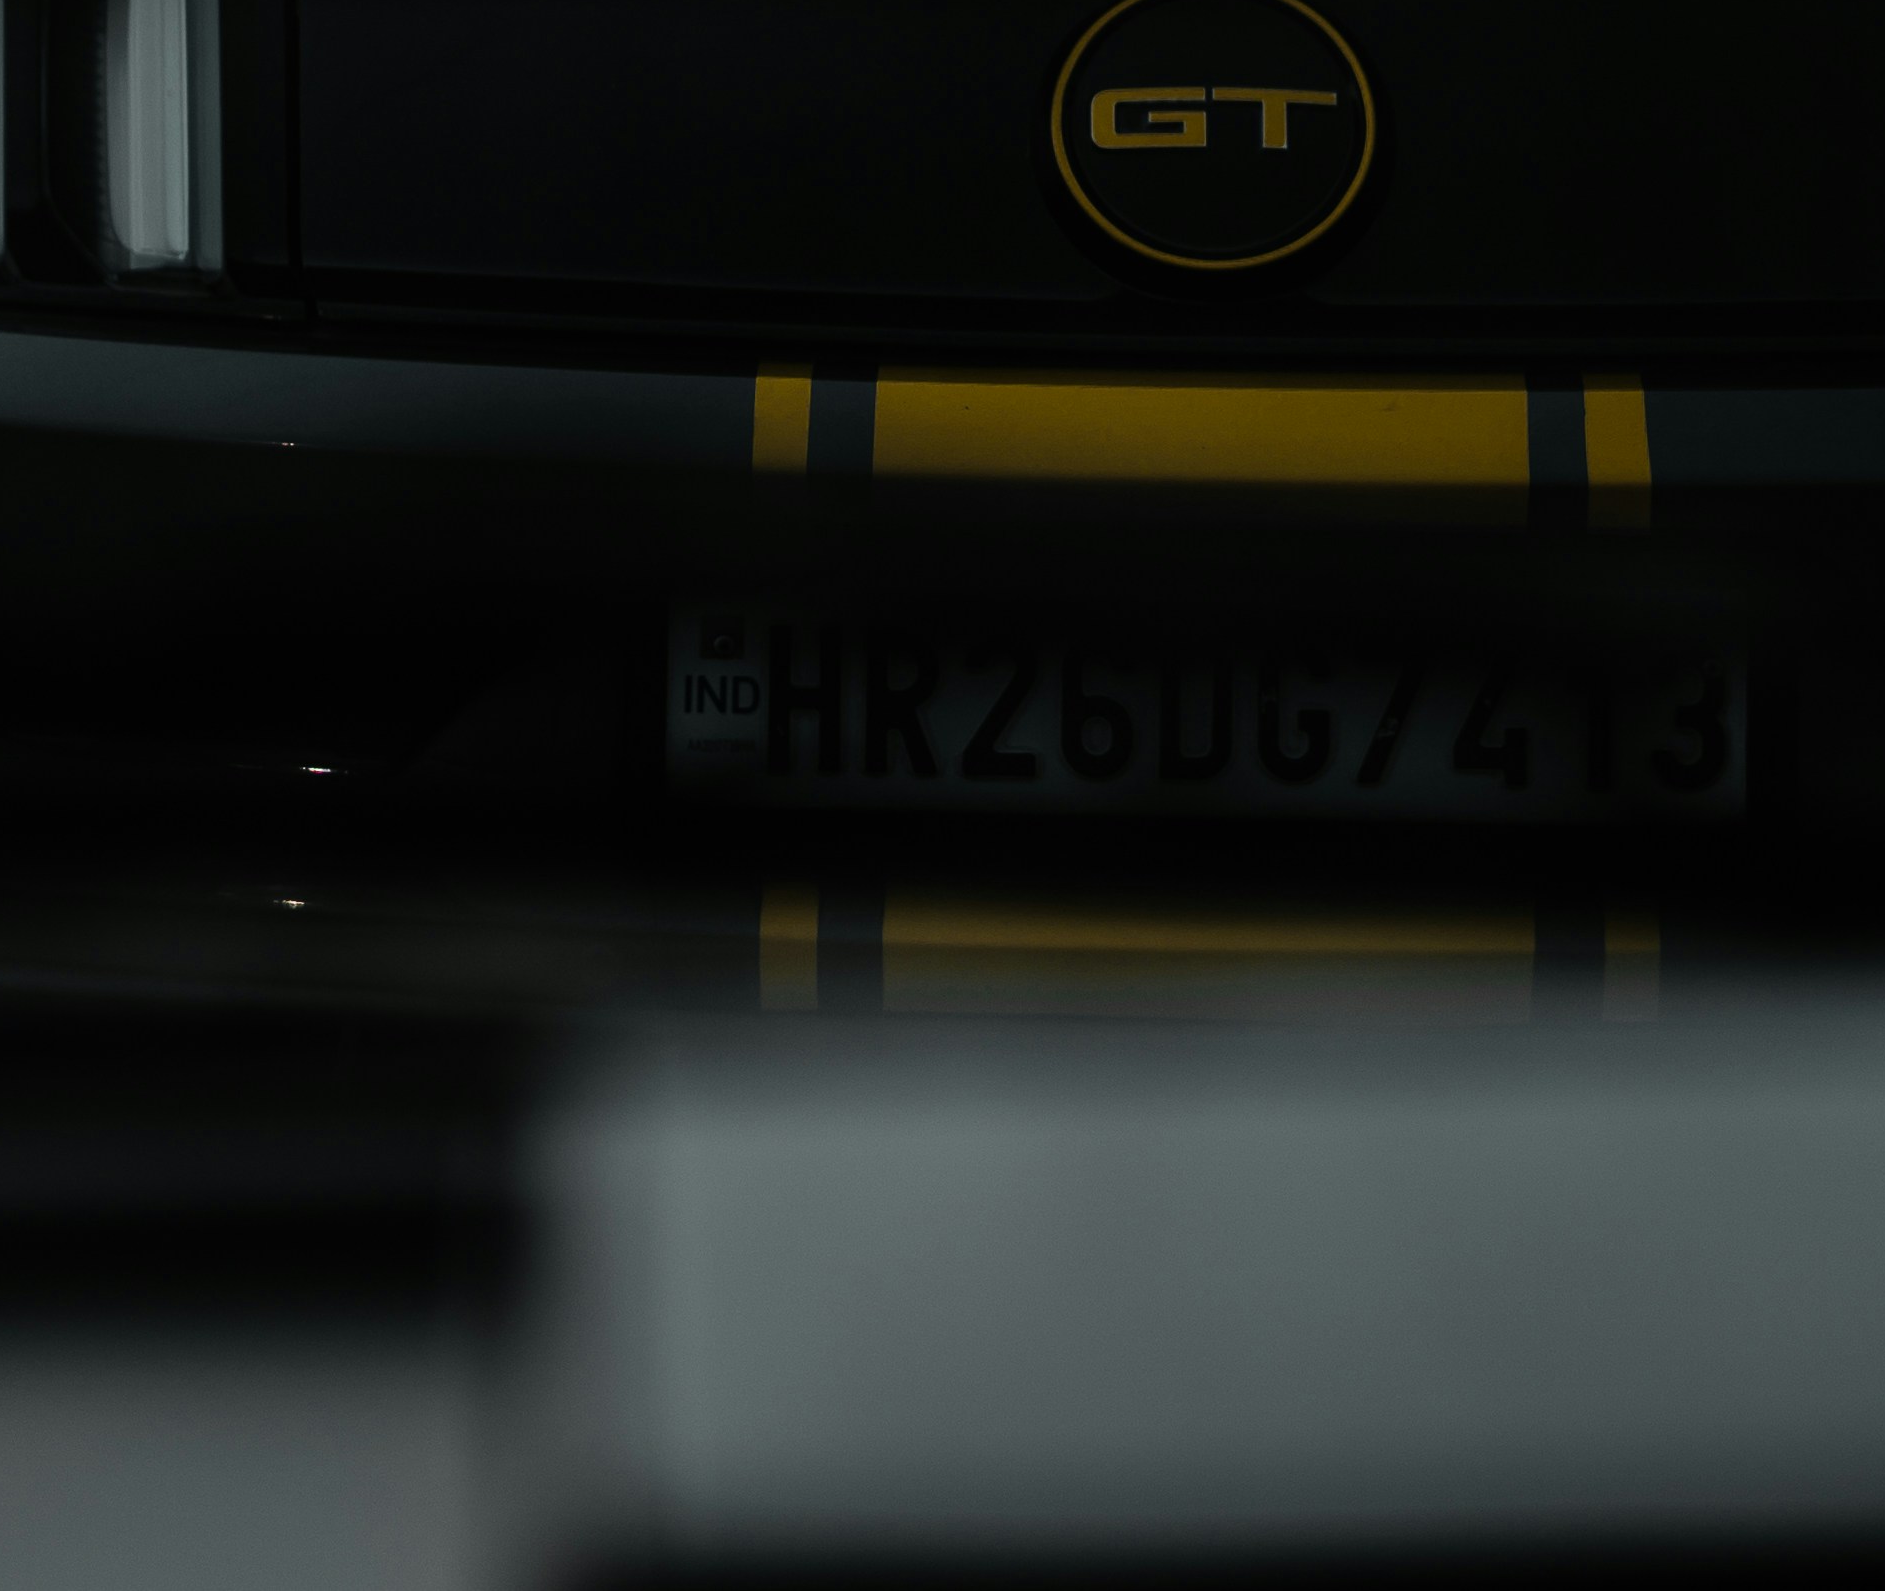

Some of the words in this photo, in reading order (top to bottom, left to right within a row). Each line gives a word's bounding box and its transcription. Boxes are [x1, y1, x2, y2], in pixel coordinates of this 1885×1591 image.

[1091, 87, 1337, 149] GT
[685, 675, 760, 714] IND
[768, 625, 1728, 791] HR26DG7413
